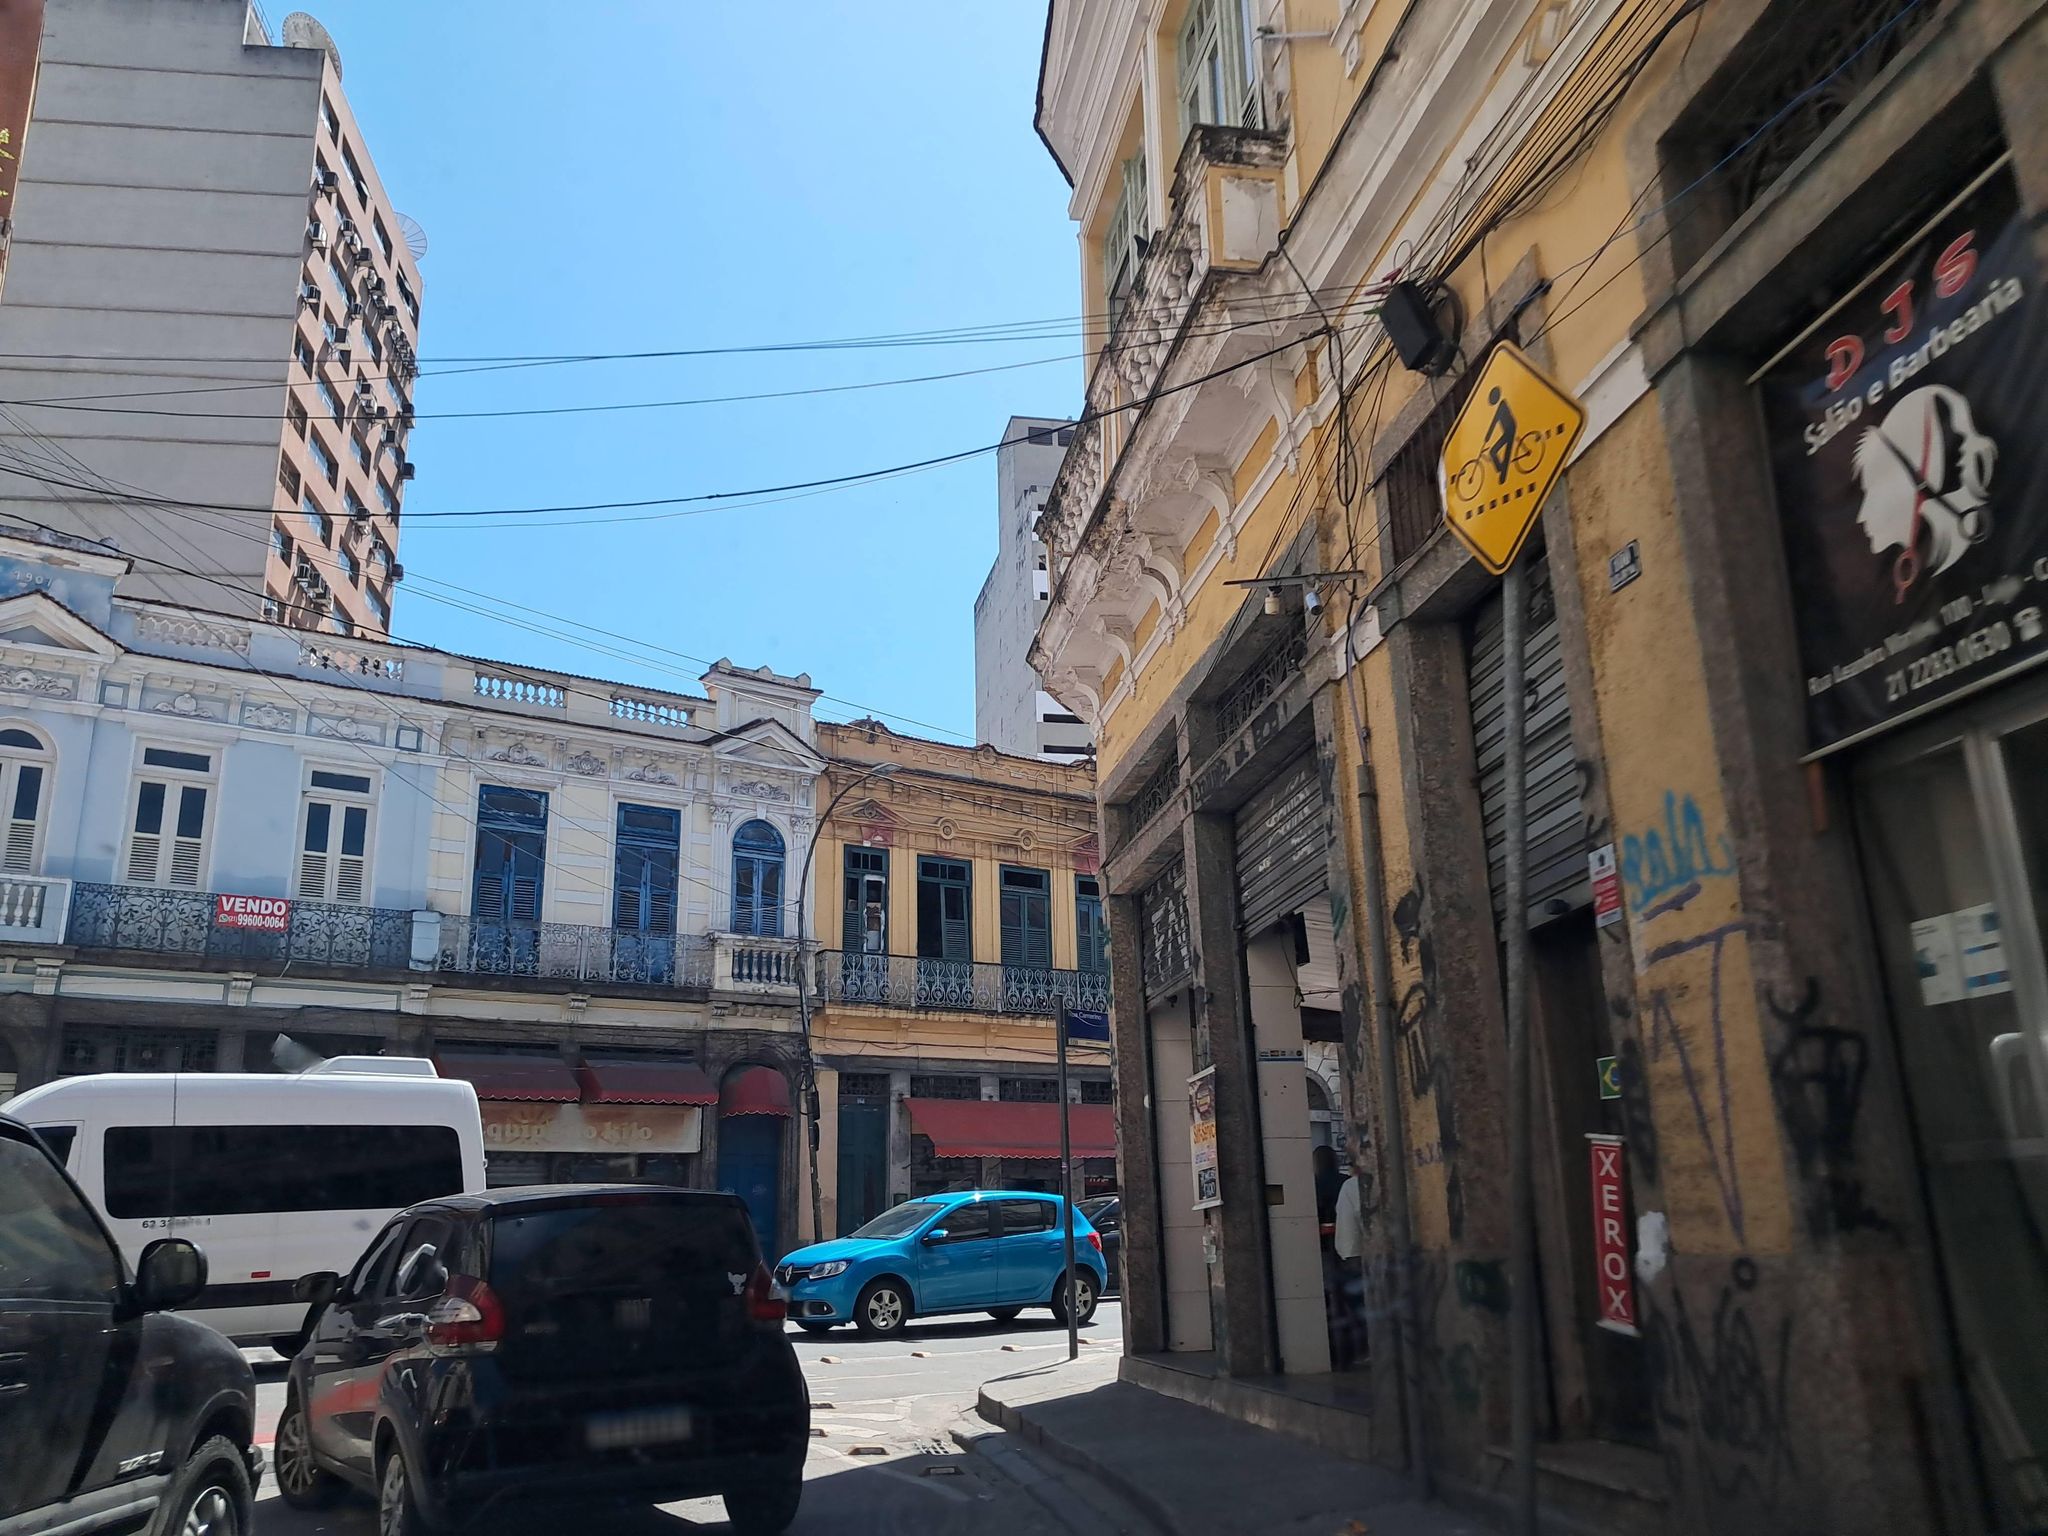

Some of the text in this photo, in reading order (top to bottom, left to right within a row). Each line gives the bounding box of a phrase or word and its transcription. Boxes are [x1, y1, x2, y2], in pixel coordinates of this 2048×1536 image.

[1803, 276, 2024, 456] Salão e Barbearia
[221, 896, 286, 916] VENDO
[1598, 1150, 1630, 1317] XEROX
